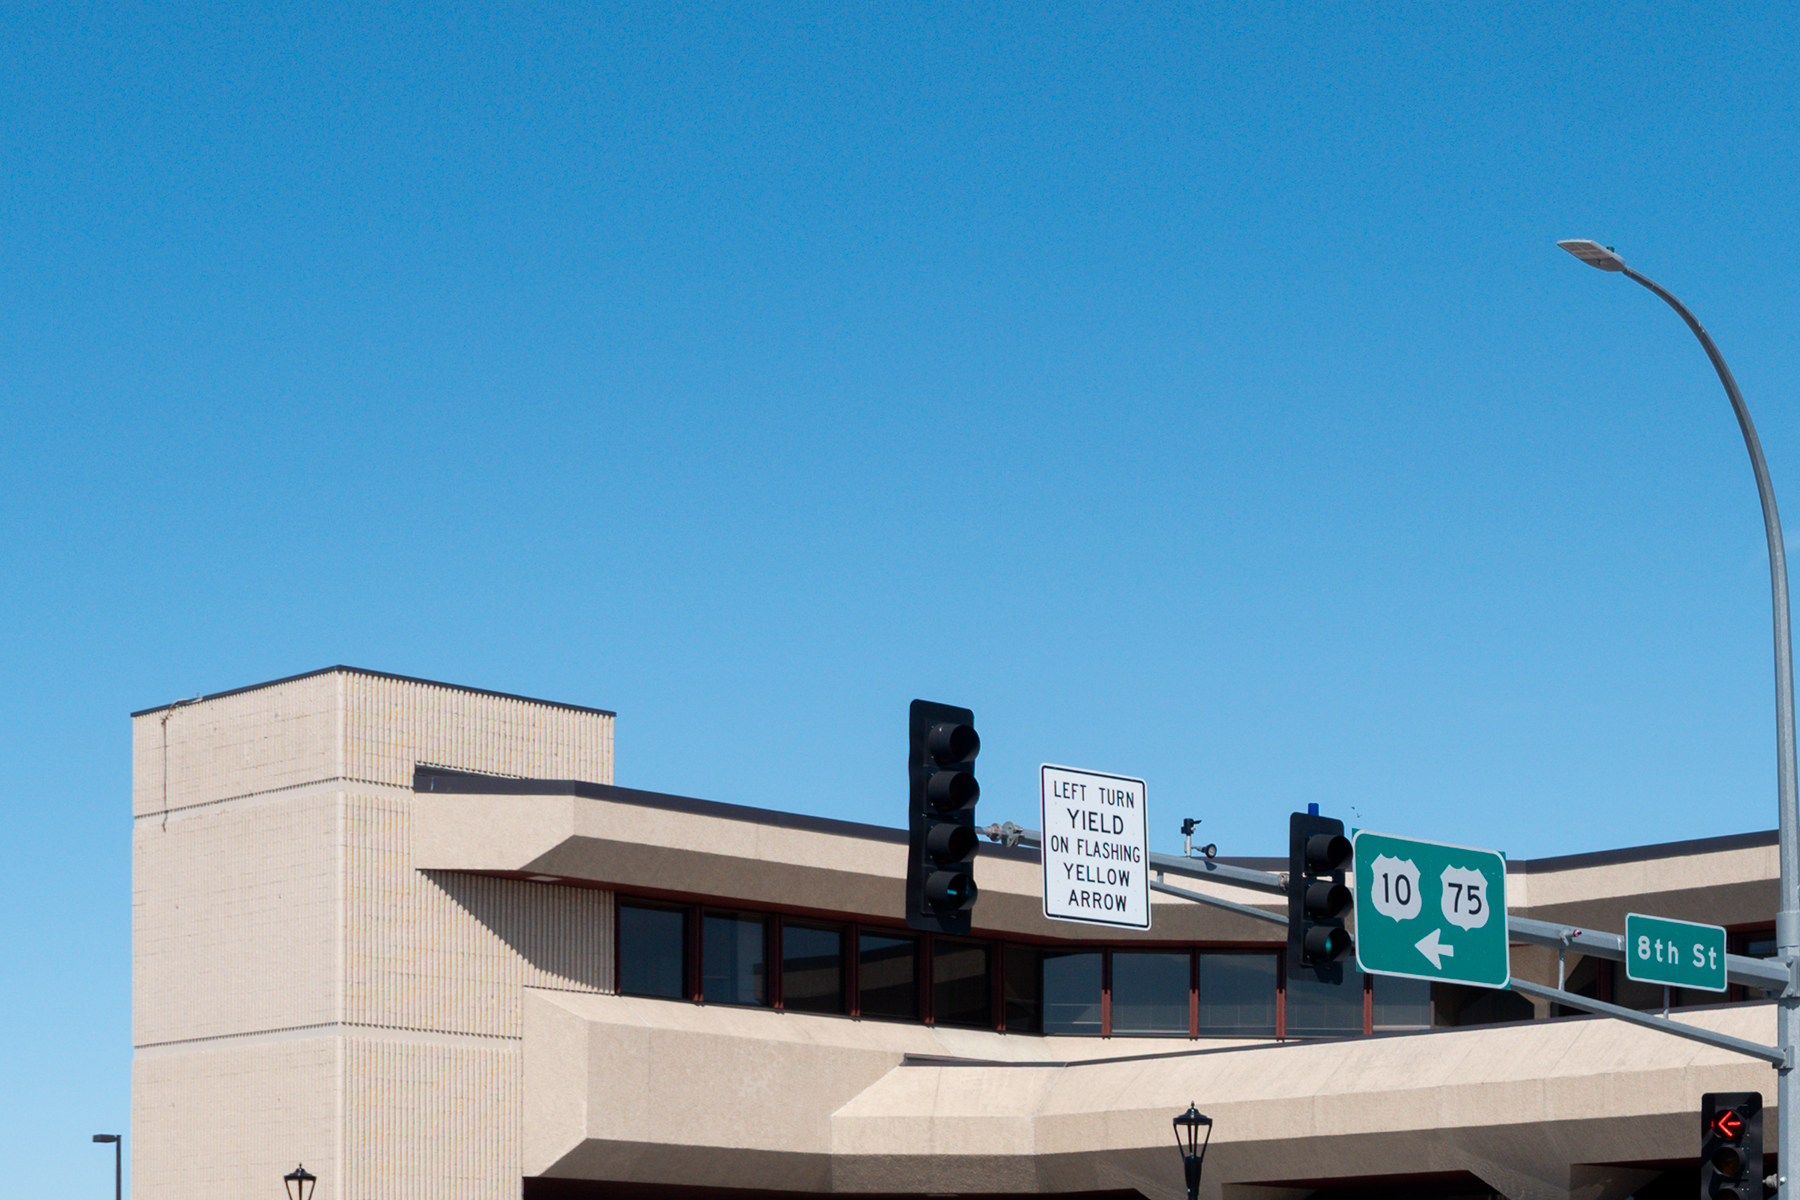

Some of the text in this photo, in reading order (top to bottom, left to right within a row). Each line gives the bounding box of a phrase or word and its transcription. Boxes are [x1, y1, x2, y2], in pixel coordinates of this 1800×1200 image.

[1054, 780, 1134, 808] LEFT TURN
[1066, 808, 1124, 835] YIELD
[1050, 834, 1141, 863] ON FLASHING
[1063, 862, 1130, 887] YELLOW
[1068, 889, 1127, 912] ARROW
[1382, 872, 1482, 915] 10 75
[1637, 935, 1717, 970] 8th St
